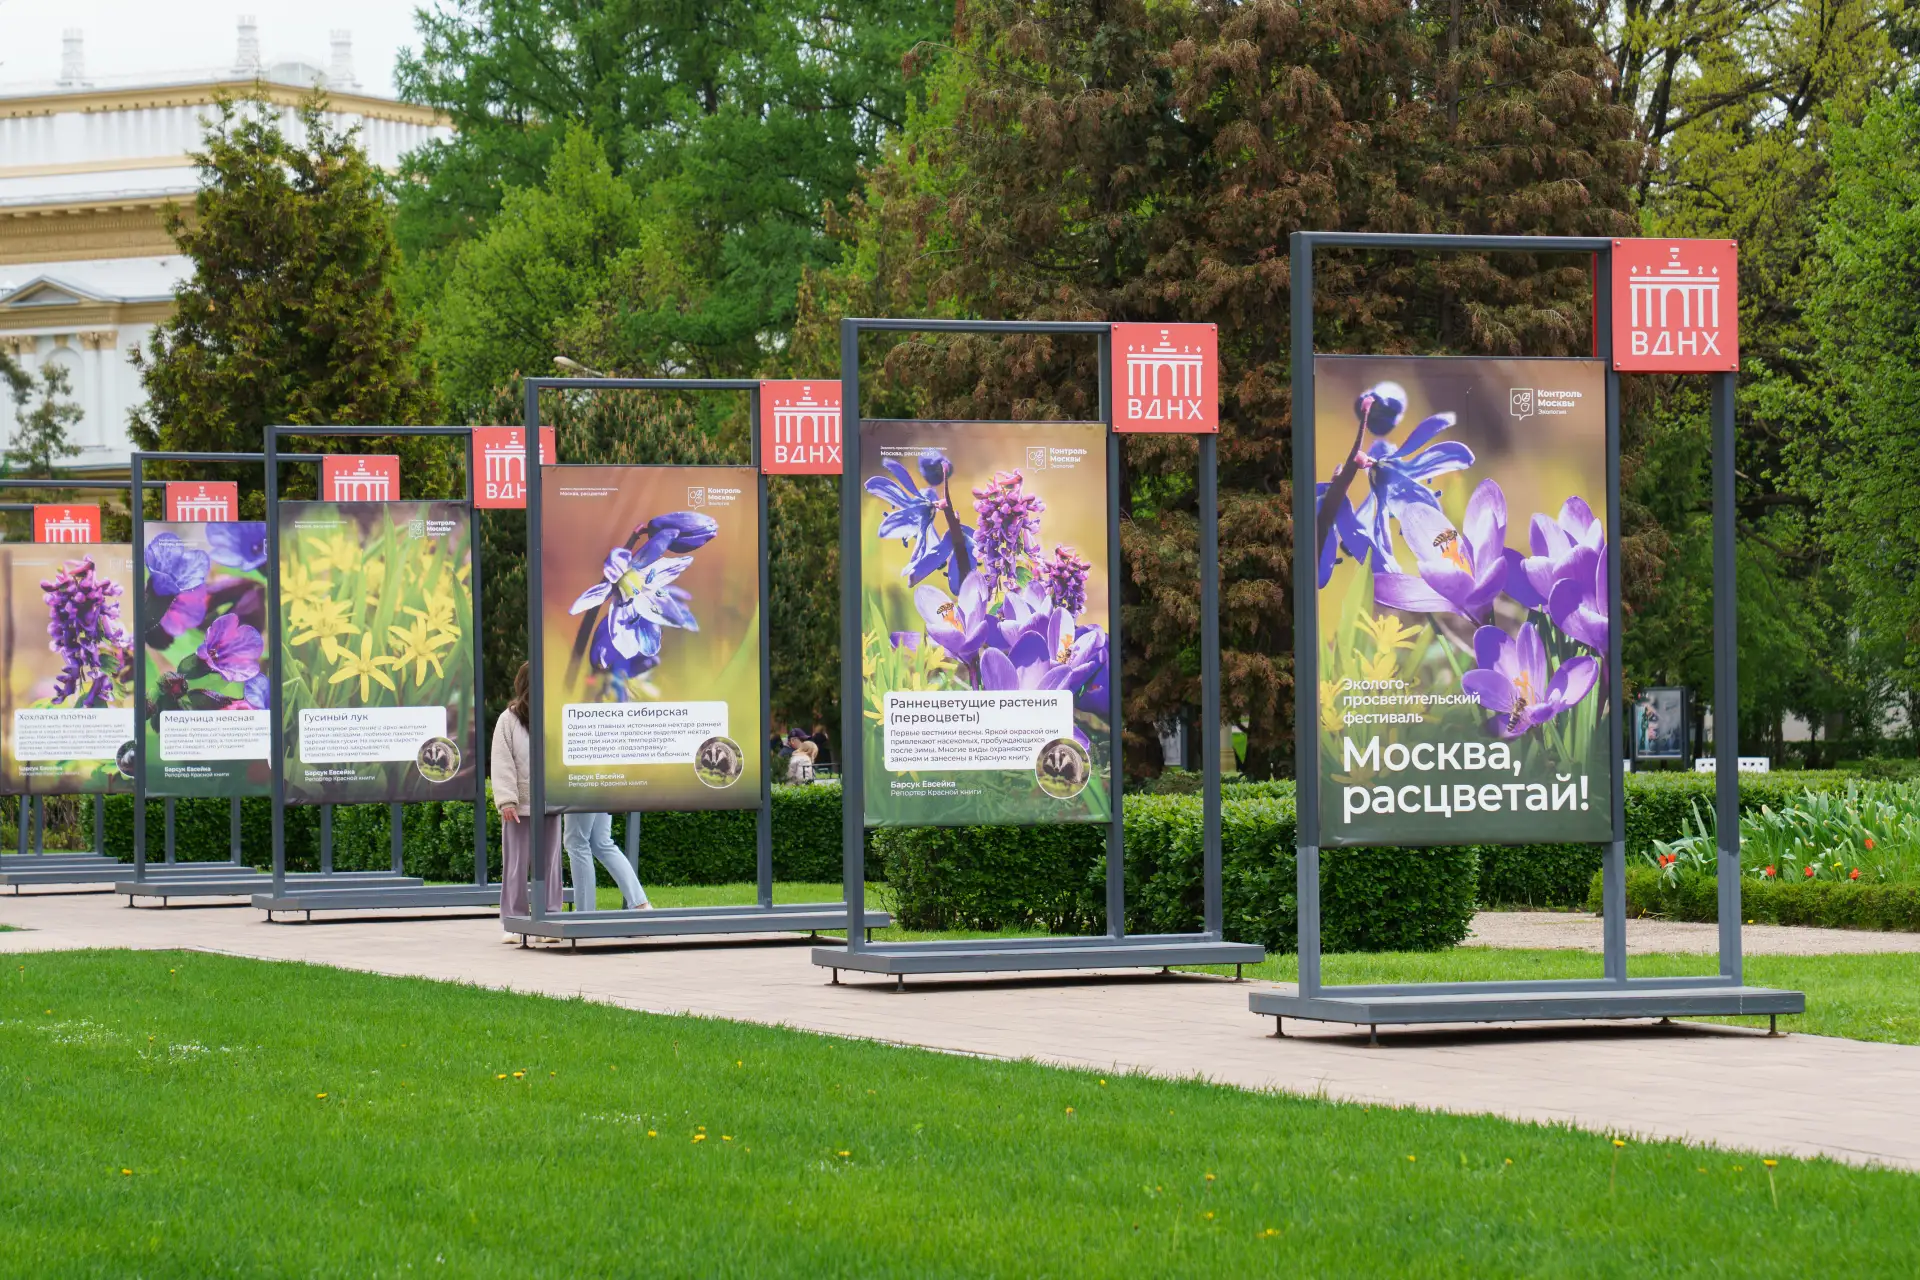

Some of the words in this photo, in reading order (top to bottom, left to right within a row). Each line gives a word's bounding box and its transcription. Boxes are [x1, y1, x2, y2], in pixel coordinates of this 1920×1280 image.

[1631, 330, 1722, 356] ВДНХ
[1538, 390, 1582, 399] Контроль
[1128, 398, 1204, 420] ВДНХ
[1538, 399, 1575, 407] Москвы
[774, 446, 841, 464] ВДНХ
[1050, 447, 1088, 456] Контроль
[486, 482, 526, 498] ВДН
[1342, 678, 1410, 690] Эколого-
[890, 698, 996, 710] Раннецветущие
[1000, 698, 1058, 710] растения
[1342, 692, 1481, 706] просветительский
[304, 713, 348, 723] Гусиный
[351, 714, 368, 722] лук
[568, 709, 624, 720] Пролеска
[627, 708, 688, 718] сибирская
[890, 712, 980, 725] (первоцветы)
[1342, 712, 1424, 726] фестиваль
[890, 729, 920, 738] Первые
[984, 728, 1008, 737] Яркой
[1009, 727, 1044, 736] окраской
[980, 736, 1046, 745] пробуждающихся
[974, 754, 1007, 763] Красную
[1343, 735, 1522, 776] Москва,
[890, 781, 920, 790] Барсук
[1343, 773, 1589, 824] расцветай!
